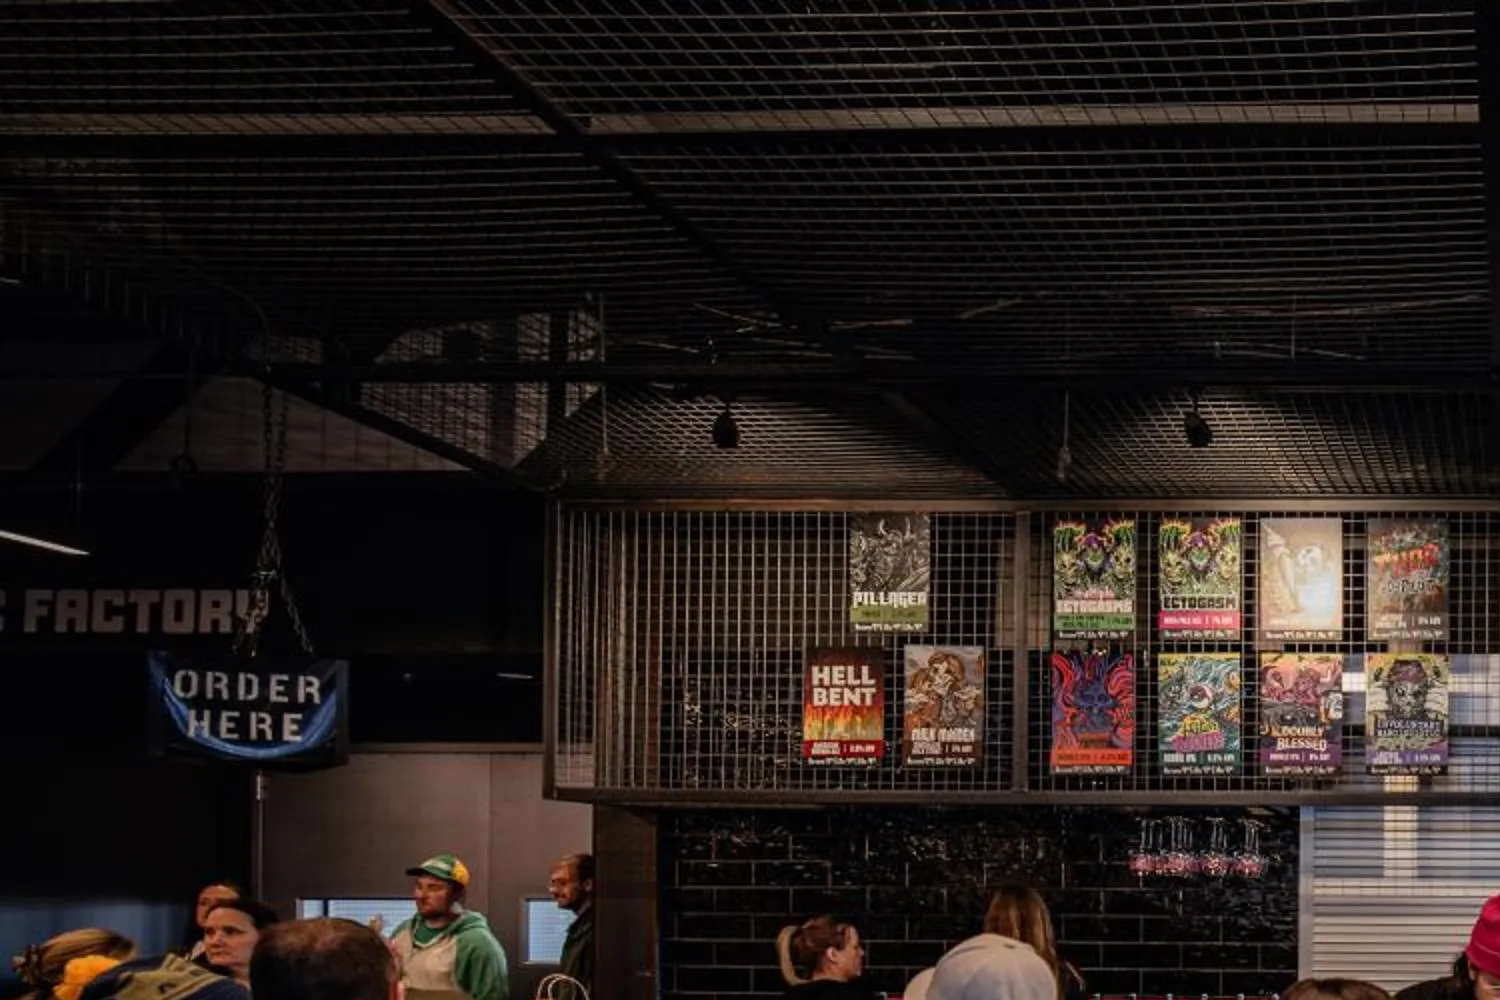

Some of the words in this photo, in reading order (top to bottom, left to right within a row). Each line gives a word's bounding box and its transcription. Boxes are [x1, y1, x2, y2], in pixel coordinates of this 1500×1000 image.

[853, 591, 927, 609] PILLAGER
[1163, 595, 1238, 609] ECTOGASM
[811, 665, 876, 687] HELL
[174, 669, 321, 704] ORDER
[813, 687, 877, 707] BENT
[187, 709, 304, 741] HERE
[1275, 738, 1327, 752] BLESSED
